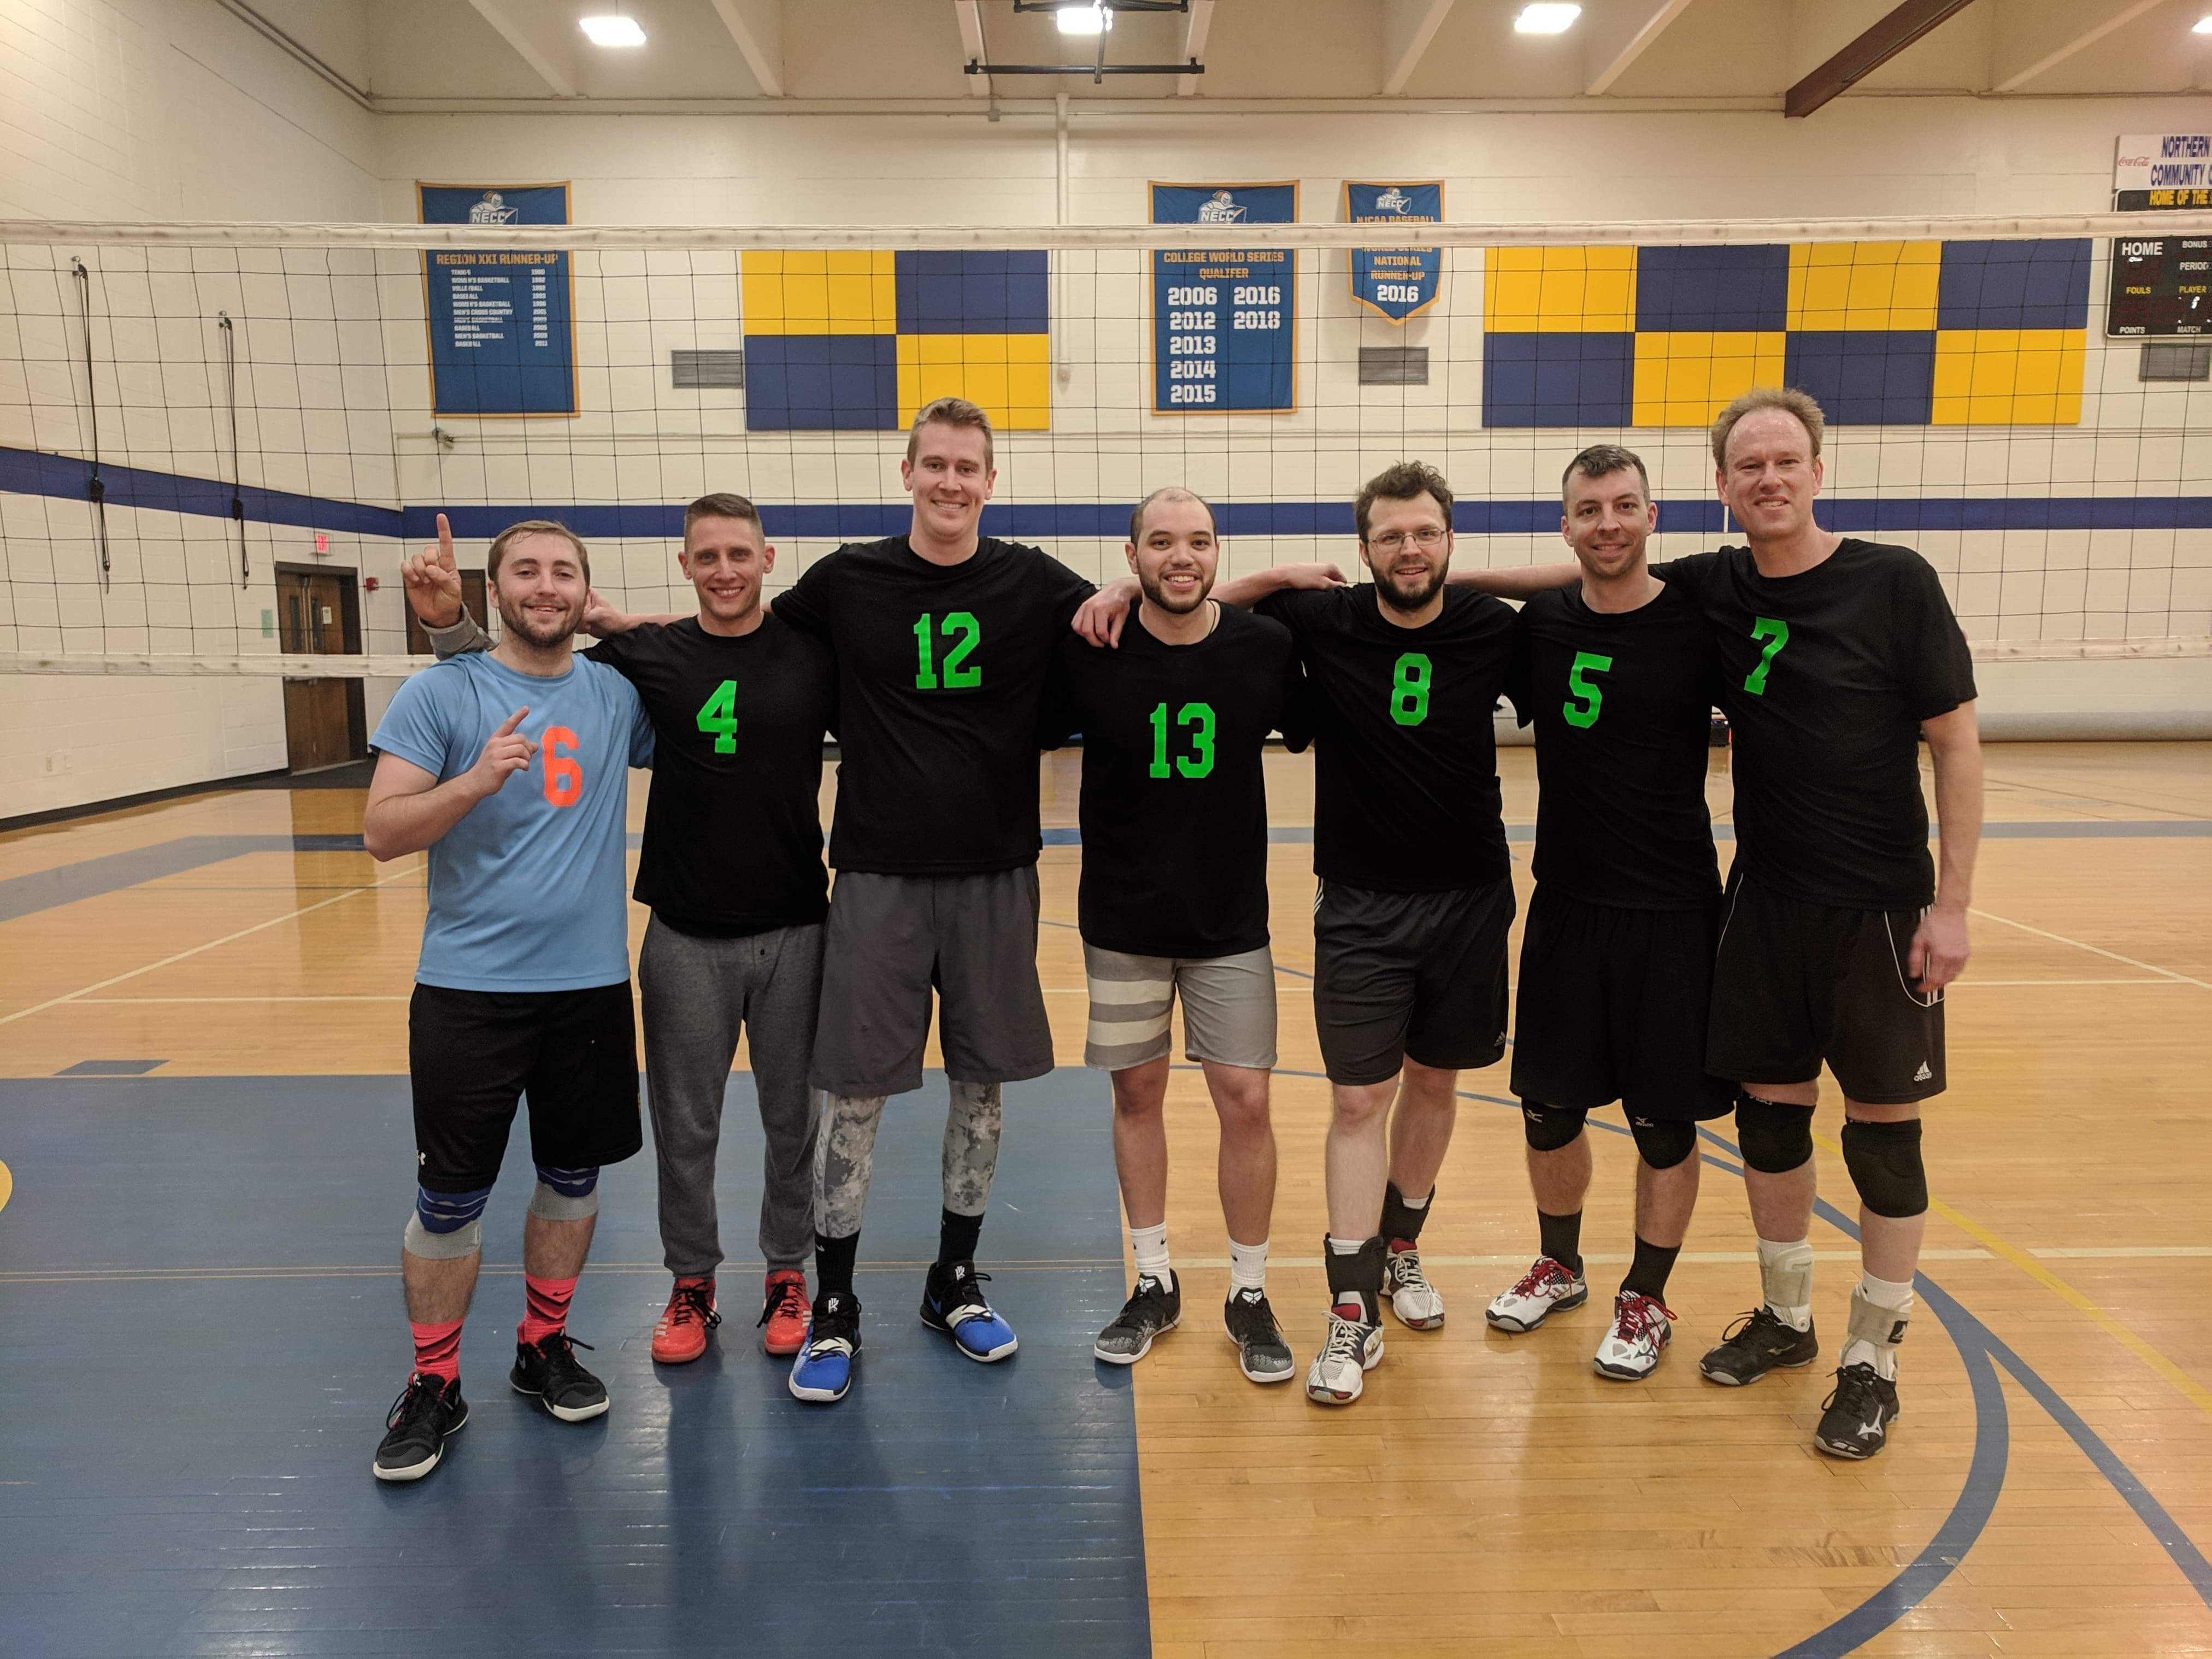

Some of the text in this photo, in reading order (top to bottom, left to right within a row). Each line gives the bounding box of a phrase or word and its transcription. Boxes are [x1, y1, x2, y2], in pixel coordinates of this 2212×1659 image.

[2161, 136, 2210, 157] NORTHERN
[2151, 164, 2205, 186] COMMUNITY
[2149, 190, 2209, 205] HOME OF THE
[472, 212, 505, 223] NECC
[1202, 210, 1234, 221] NECC
[1164, 251, 1284, 263] COLLEGE WORLD SERIES
[2122, 242, 2163, 255] HOME
[437, 254, 558, 264] REGION XXI RUNNER-UP
[1374, 256, 1421, 266] NATIONAL
[2180, 262, 2209, 270] PERIOD
[1370, 270, 1425, 280] RUNNER-UP
[1168, 286, 1280, 305] 2006 2016
[1377, 285, 1419, 303] 2016
[1170, 311, 1280, 330] 2012 2018
[1170, 336, 1216, 355] 2013
[1170, 360, 1216, 379] 2014
[1170, 385, 1216, 403] 2015
[914, 611, 981, 689] 12
[1743, 616, 1789, 696] 7
[1390, 652, 1432, 726] 8
[1563, 651, 1613, 728] 5
[696, 680, 737, 754] 4
[1150, 703, 1215, 778] 13
[541, 726, 582, 807] 6
[1914, 1072, 1932, 1082] adidas
